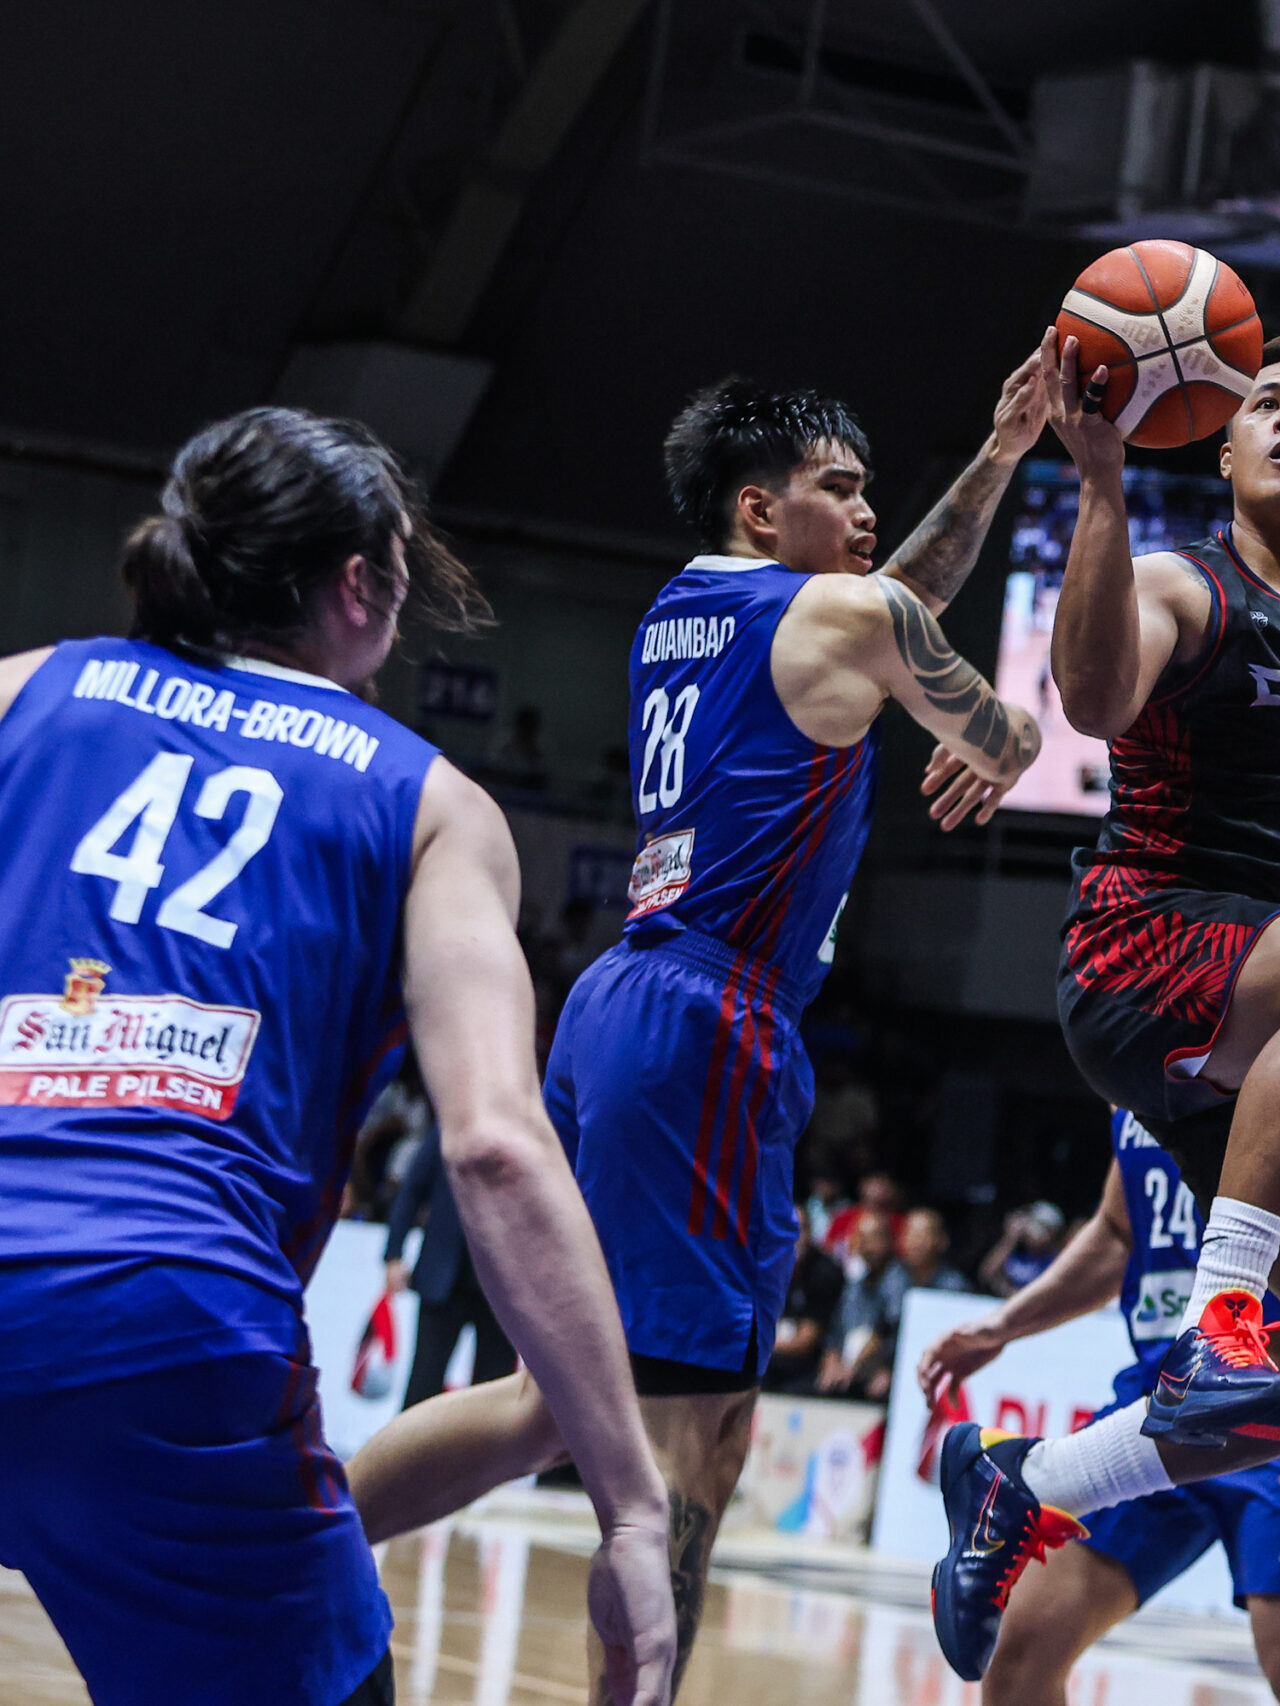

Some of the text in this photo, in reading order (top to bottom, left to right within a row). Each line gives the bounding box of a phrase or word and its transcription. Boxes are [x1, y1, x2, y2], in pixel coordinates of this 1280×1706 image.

[641, 616, 736, 664] QUIAMBAO
[72, 659, 380, 773] MILLORA-BROWN
[639, 683, 700, 815] 28
[70, 751, 284, 949] 42
[13, 1009, 234, 1064] San Miguel
[28, 1074, 223, 1110] PALE PILSEN
[1144, 1167, 1198, 1249] 24
